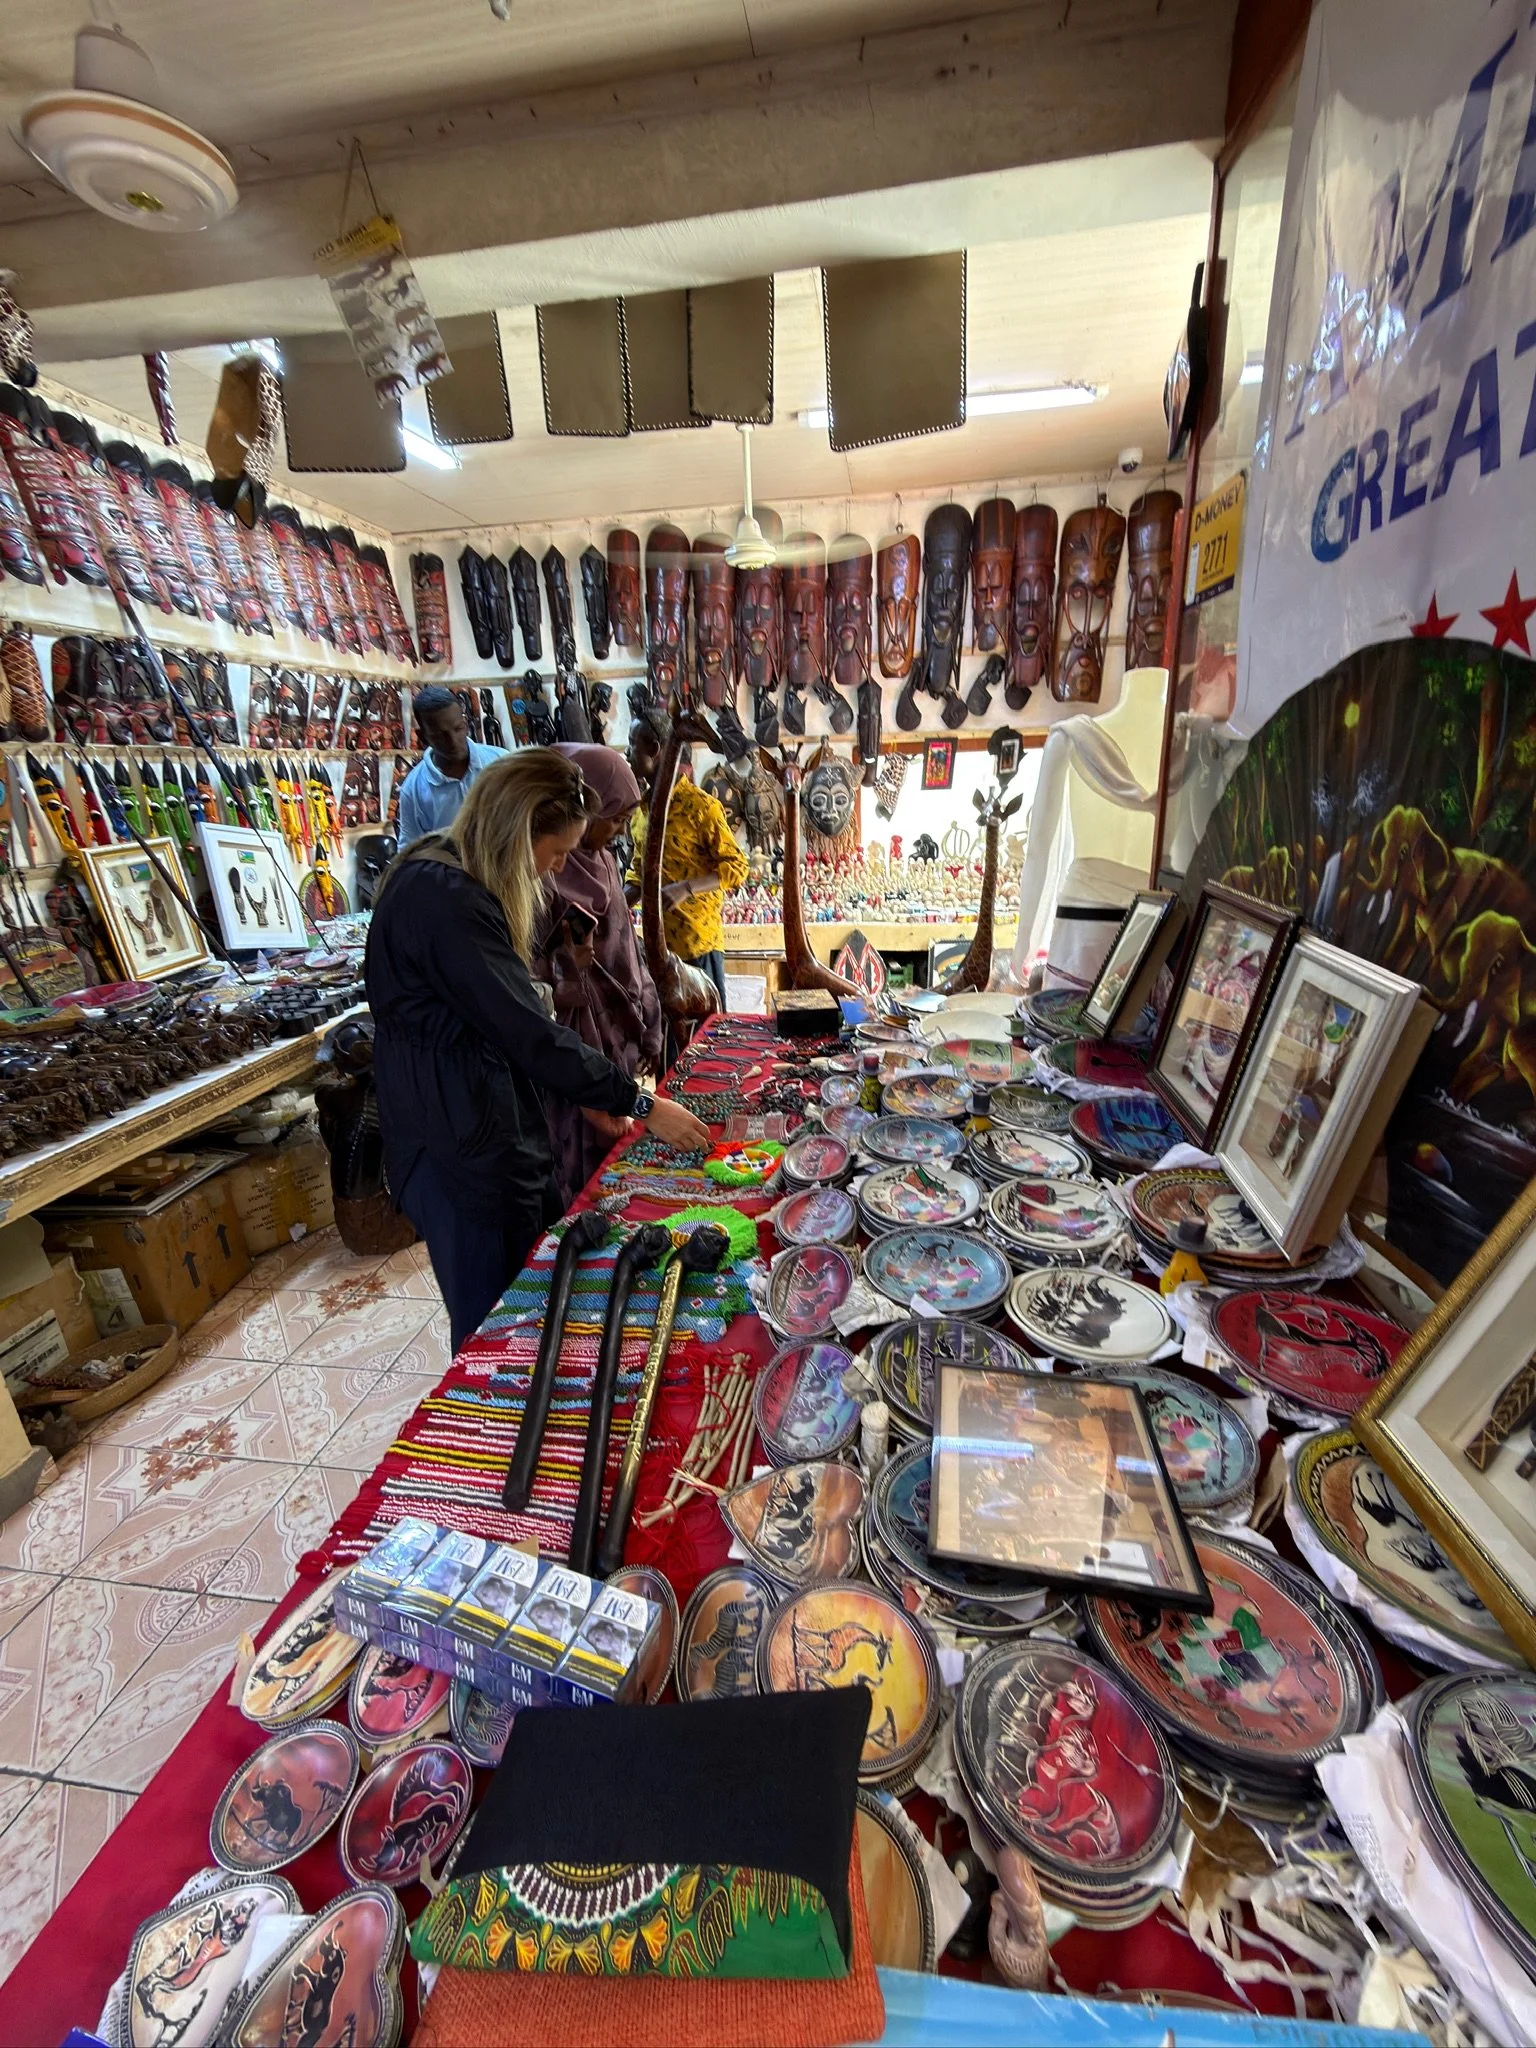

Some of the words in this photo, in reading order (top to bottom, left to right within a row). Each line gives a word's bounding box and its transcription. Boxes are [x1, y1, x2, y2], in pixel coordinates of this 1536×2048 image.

[1194, 483, 1241, 533] D-MONEY
[1202, 530, 1229, 575] 2771
[400, 1616, 419, 1638] L&M
[401, 1640, 420, 1662] L&M
[454, 1637, 474, 1660] L&M
[455, 1661, 475, 1683] L&M
[511, 1662, 532, 1685] L&M
[512, 1686, 532, 1707] L&M
[572, 1685, 594, 1707] L&M
